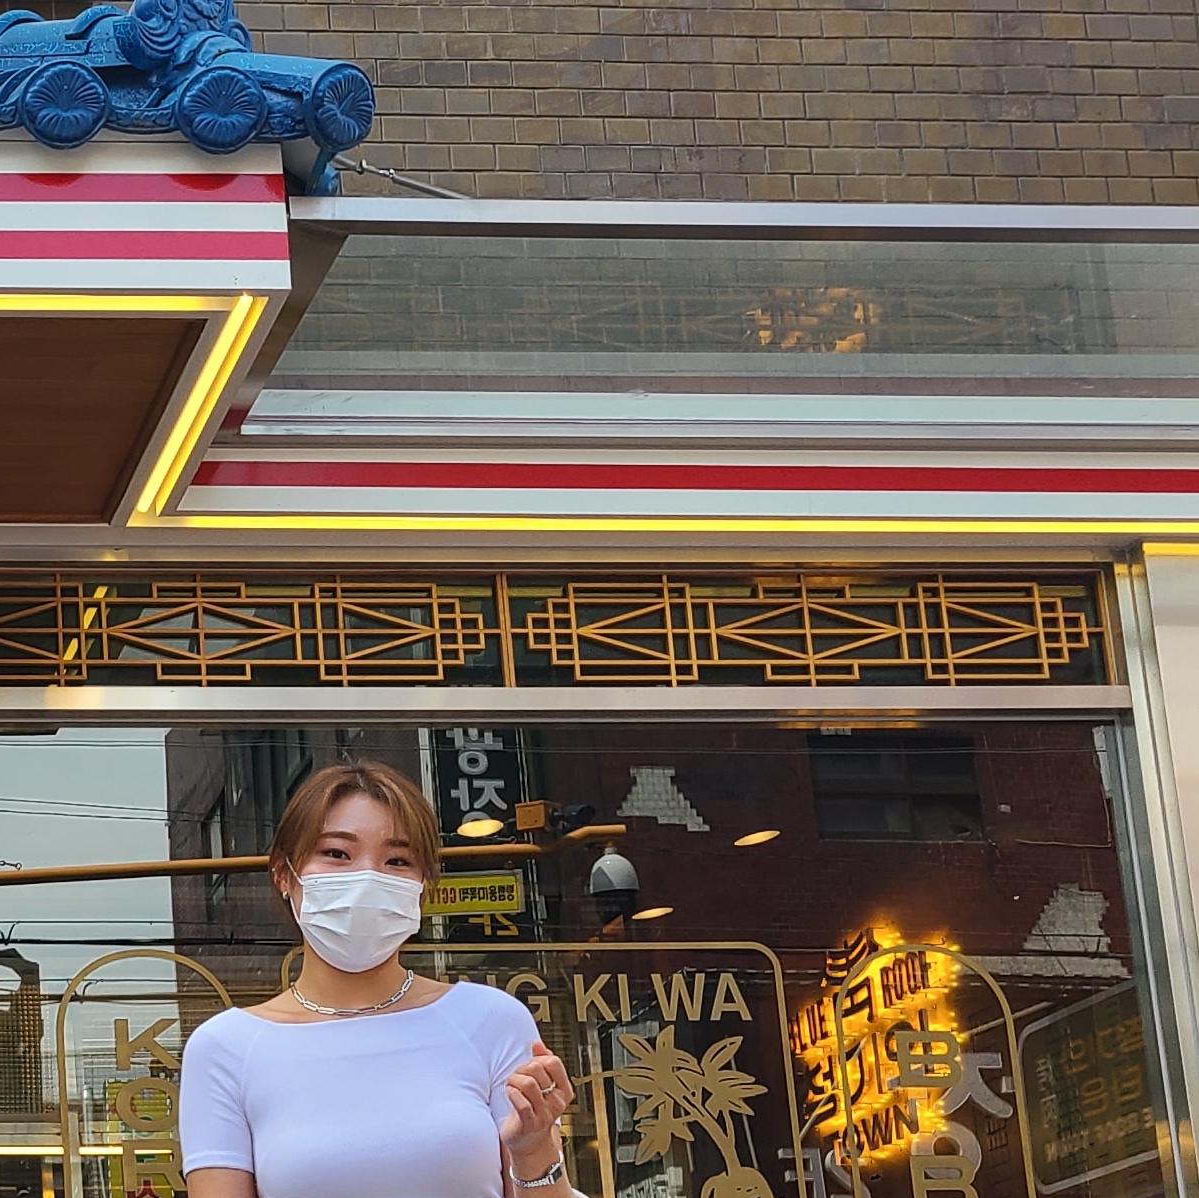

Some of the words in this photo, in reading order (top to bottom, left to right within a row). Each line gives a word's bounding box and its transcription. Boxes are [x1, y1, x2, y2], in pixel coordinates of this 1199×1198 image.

[573, 973, 633, 1023] KI
[651, 971, 753, 1022] WA
[788, 997, 836, 1056] BLUE
[879, 950, 933, 1009] ROOF
